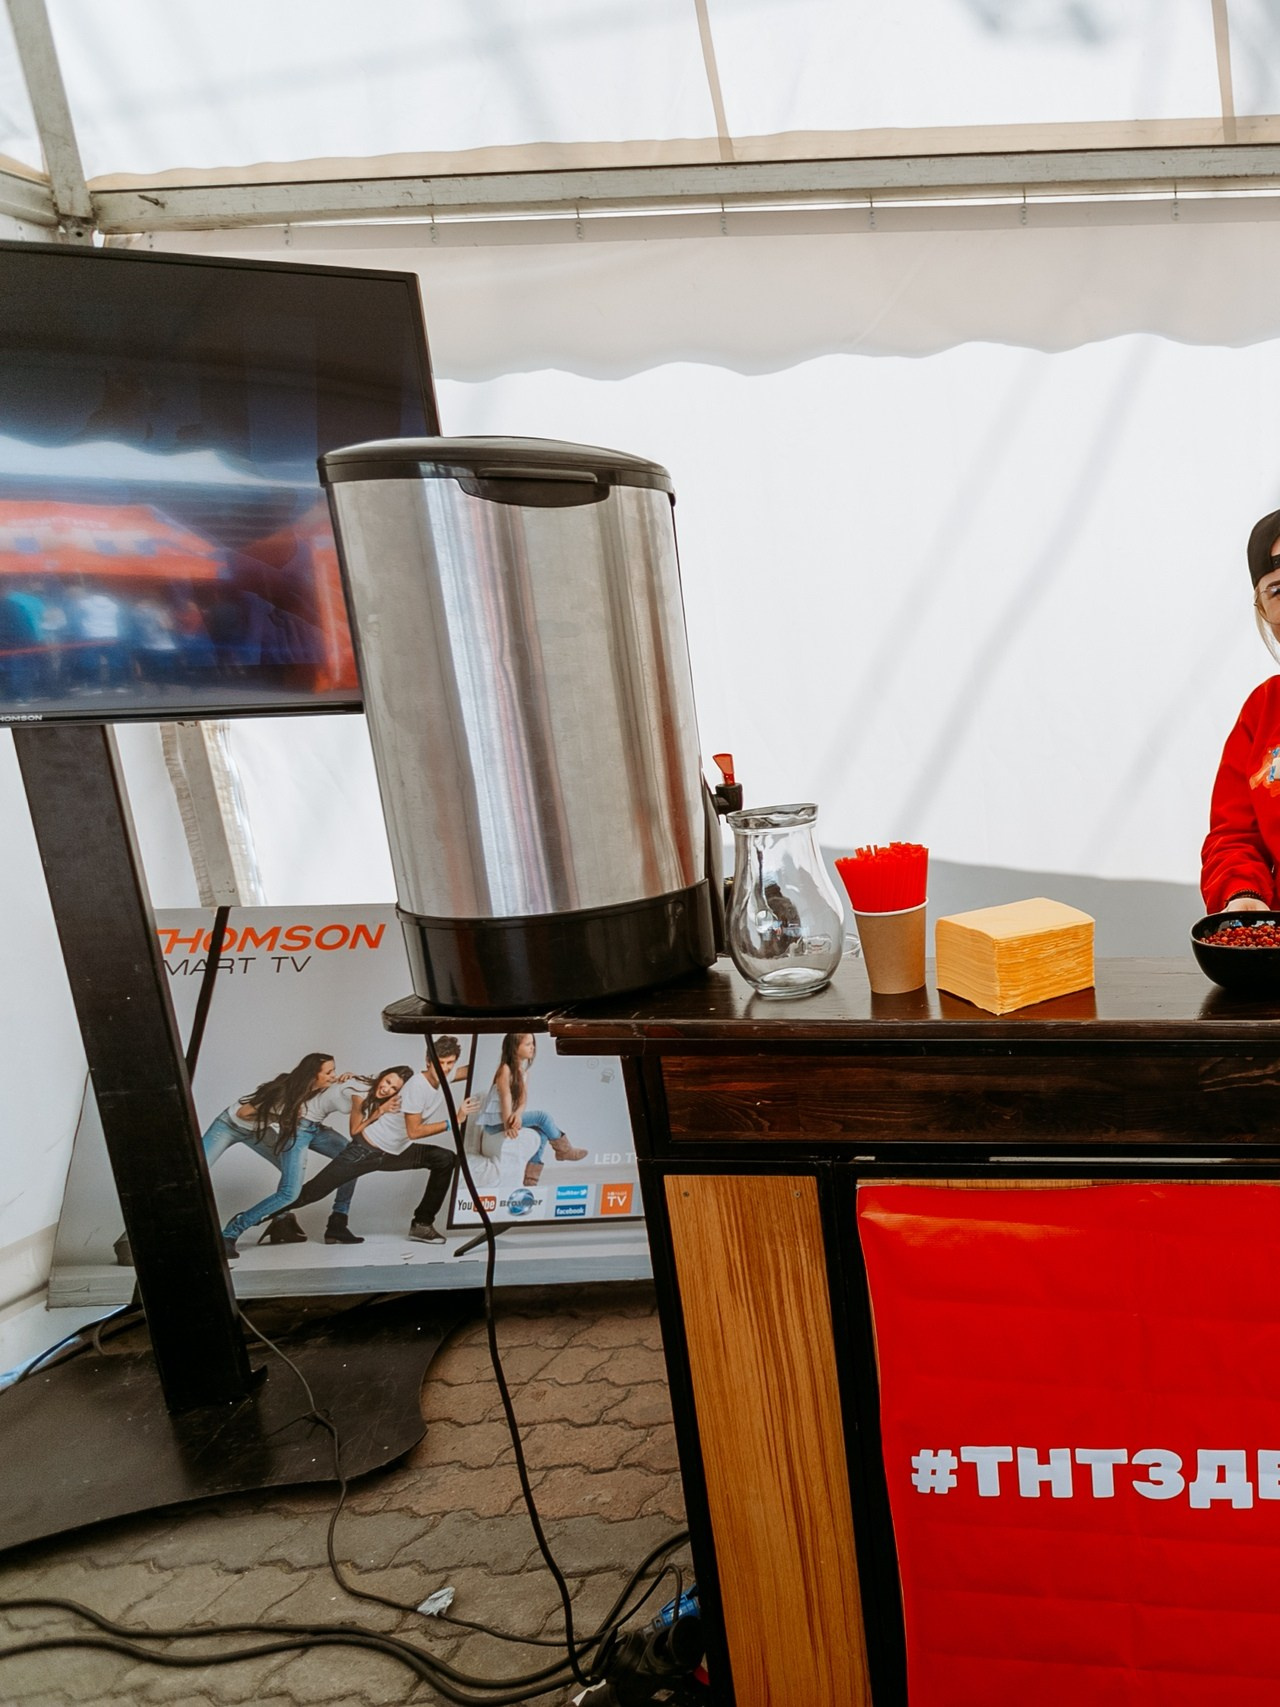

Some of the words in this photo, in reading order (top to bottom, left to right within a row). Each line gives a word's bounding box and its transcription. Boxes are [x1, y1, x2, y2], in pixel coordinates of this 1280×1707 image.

[163, 956, 256, 976] MART
[271, 955, 312, 974] TV
[594, 1152, 621, 1165] LED
[625, 1152, 637, 1164] T
[607, 1195, 627, 1208] TV
[556, 1207, 584, 1215] facebook
